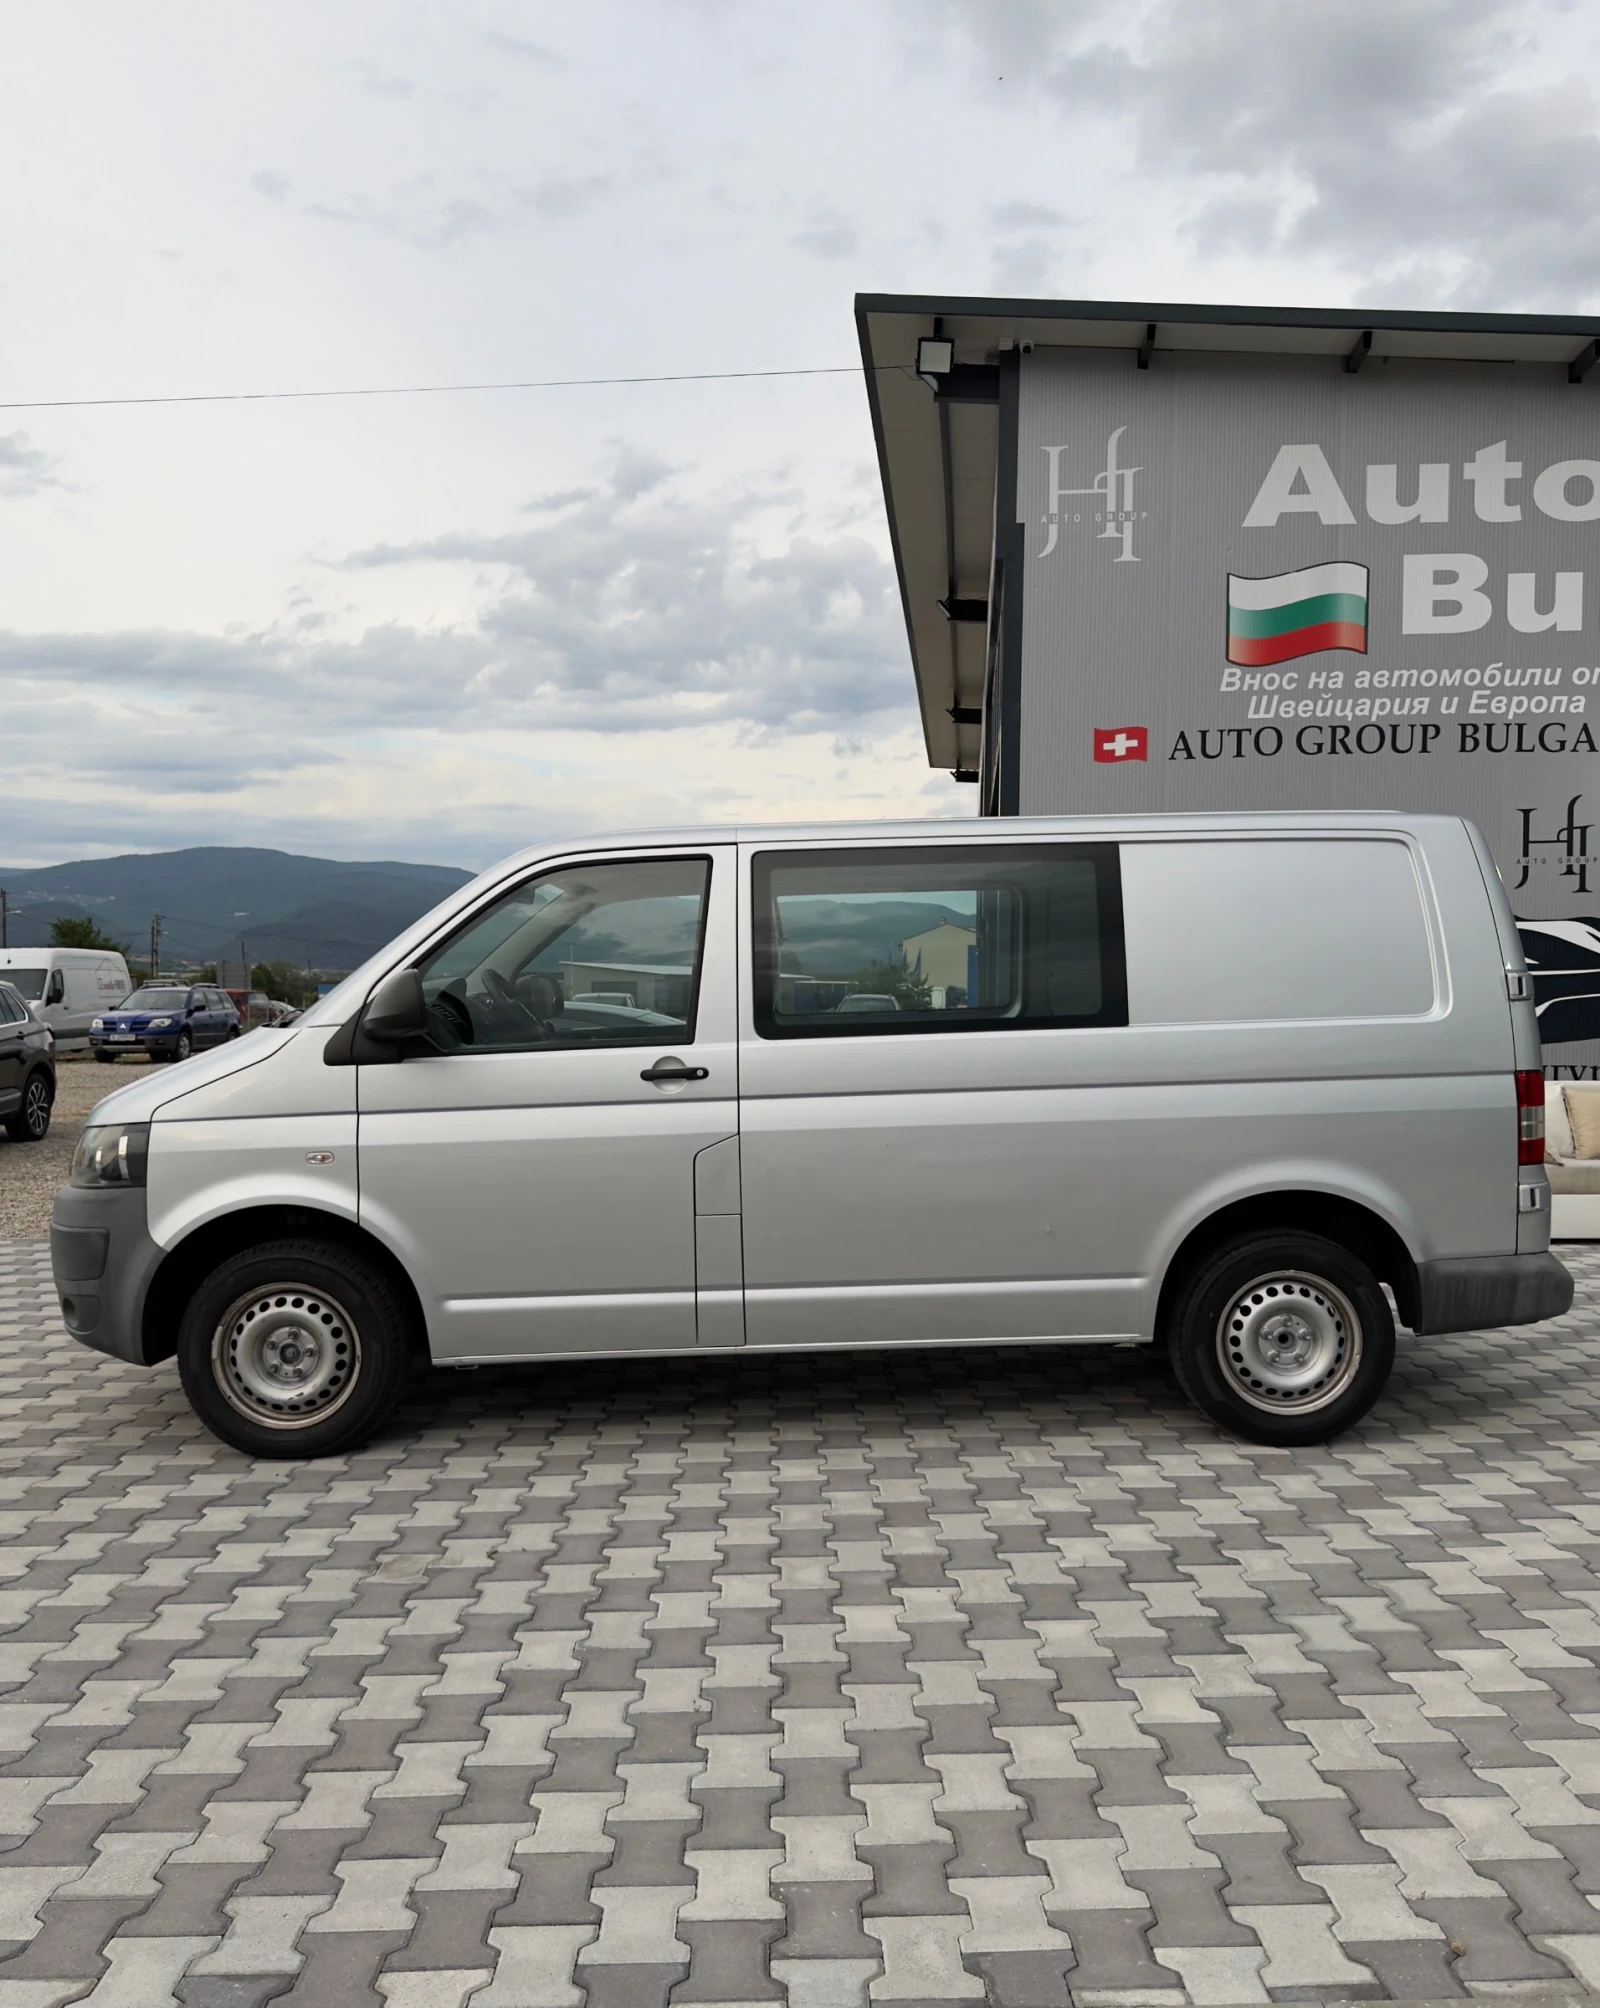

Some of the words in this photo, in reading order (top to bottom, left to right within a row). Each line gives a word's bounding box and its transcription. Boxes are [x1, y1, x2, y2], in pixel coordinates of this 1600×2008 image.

[1242, 439, 1600, 527] Auto
[1041, 514, 1081, 524] AUTO
[1095, 511, 1148, 522] GROUP
[1402, 553, 1584, 634] Bu
[1220, 668, 1299, 692] Внос
[1307, 670, 1344, 689] на
[1354, 662, 1562, 688] автомобили
[1247, 692, 1430, 721] Швейцария
[1440, 696, 1459, 714] и
[1468, 690, 1586, 720] Европа
[1168, 726, 1283, 761] AUTO
[1295, 723, 1441, 755] GROUP
[1457, 722, 1599, 753] BULGA
[1516, 857, 1547, 865] AUTO
[1557, 856, 1598, 864] GROUP
